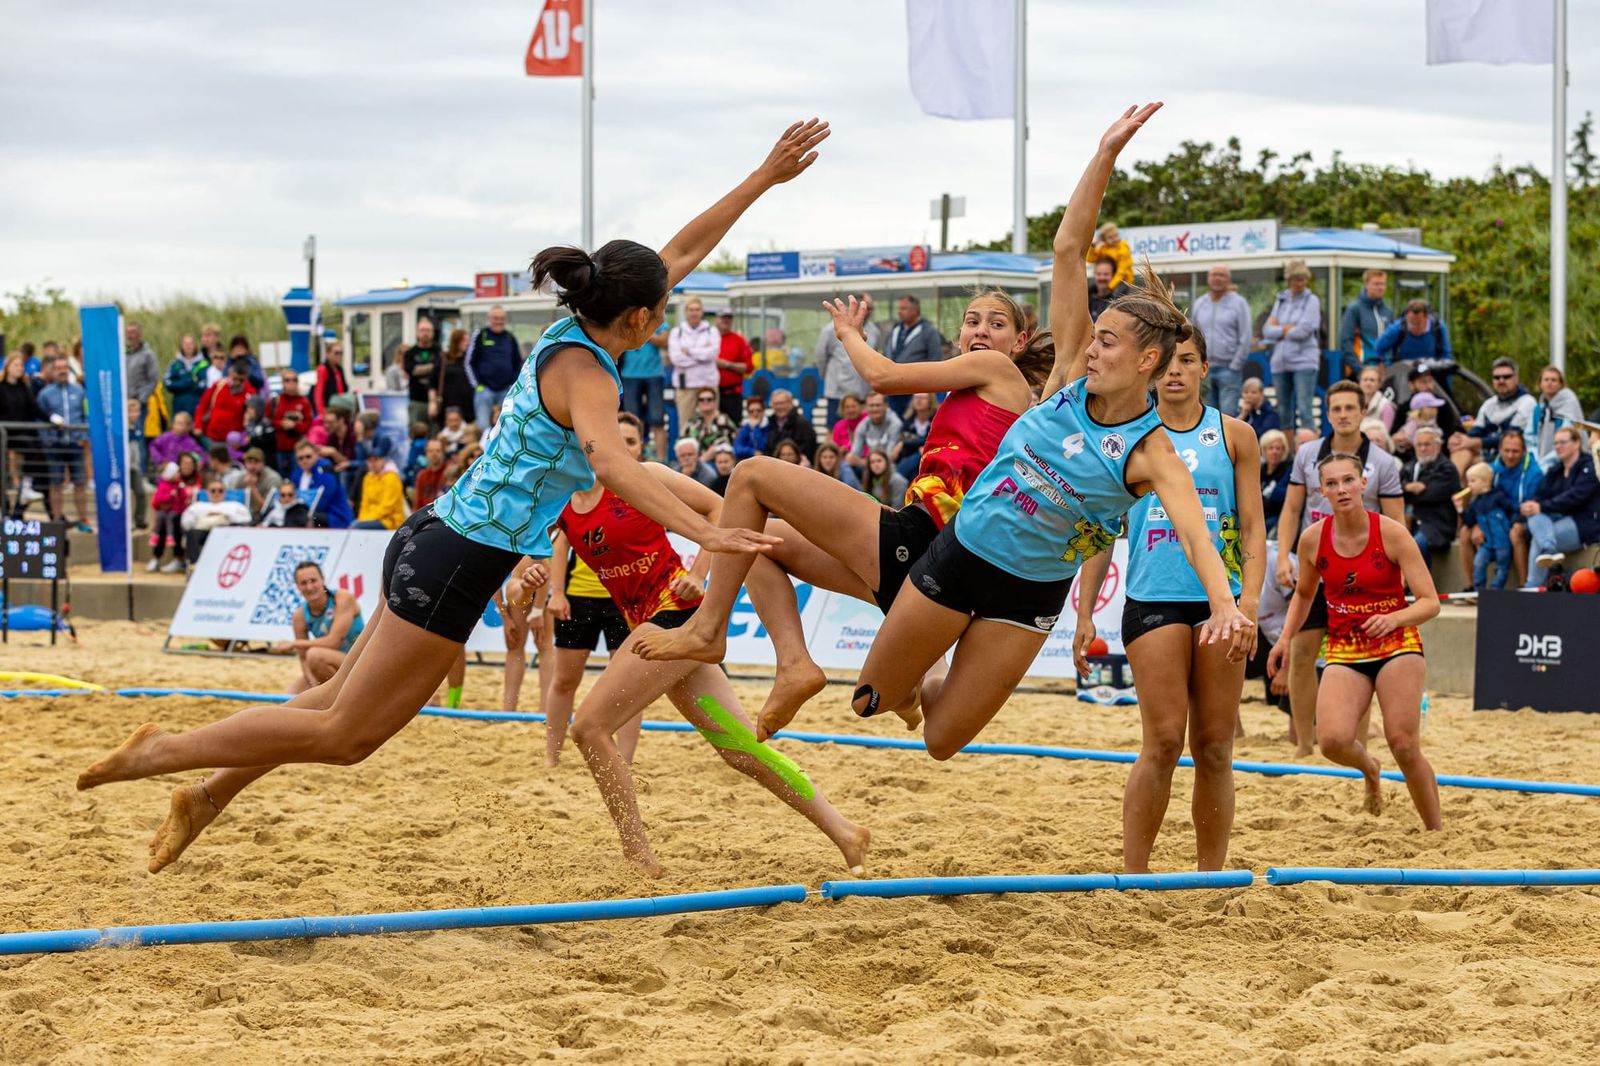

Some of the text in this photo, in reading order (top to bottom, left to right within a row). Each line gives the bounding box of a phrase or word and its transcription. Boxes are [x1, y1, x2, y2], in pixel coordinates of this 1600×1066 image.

[1062, 432, 1085, 460] 4
[1023, 443, 1087, 503] CONSULTENS
[1013, 490, 1039, 516] PRO
[583, 527, 605, 548] 16
[1515, 633, 1562, 657] DHB
